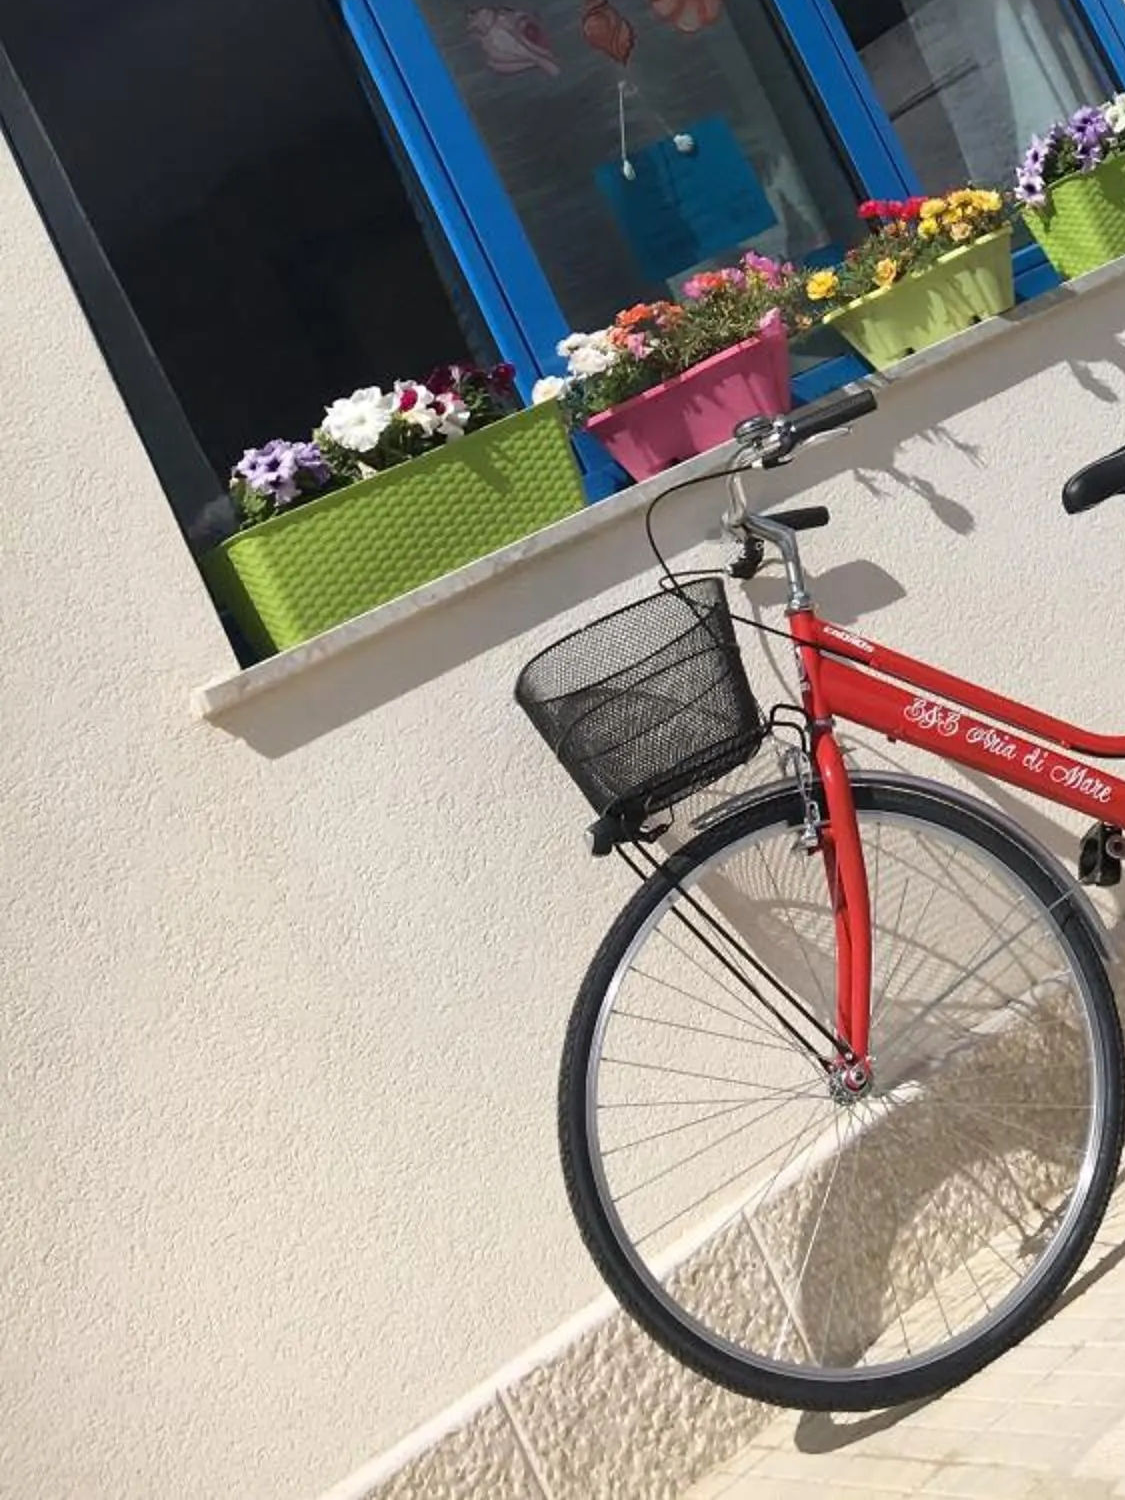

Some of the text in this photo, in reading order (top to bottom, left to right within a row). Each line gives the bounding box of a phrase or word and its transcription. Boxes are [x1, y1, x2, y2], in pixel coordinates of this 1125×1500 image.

[903, 697, 1113, 803] B&B Aria di Mare
